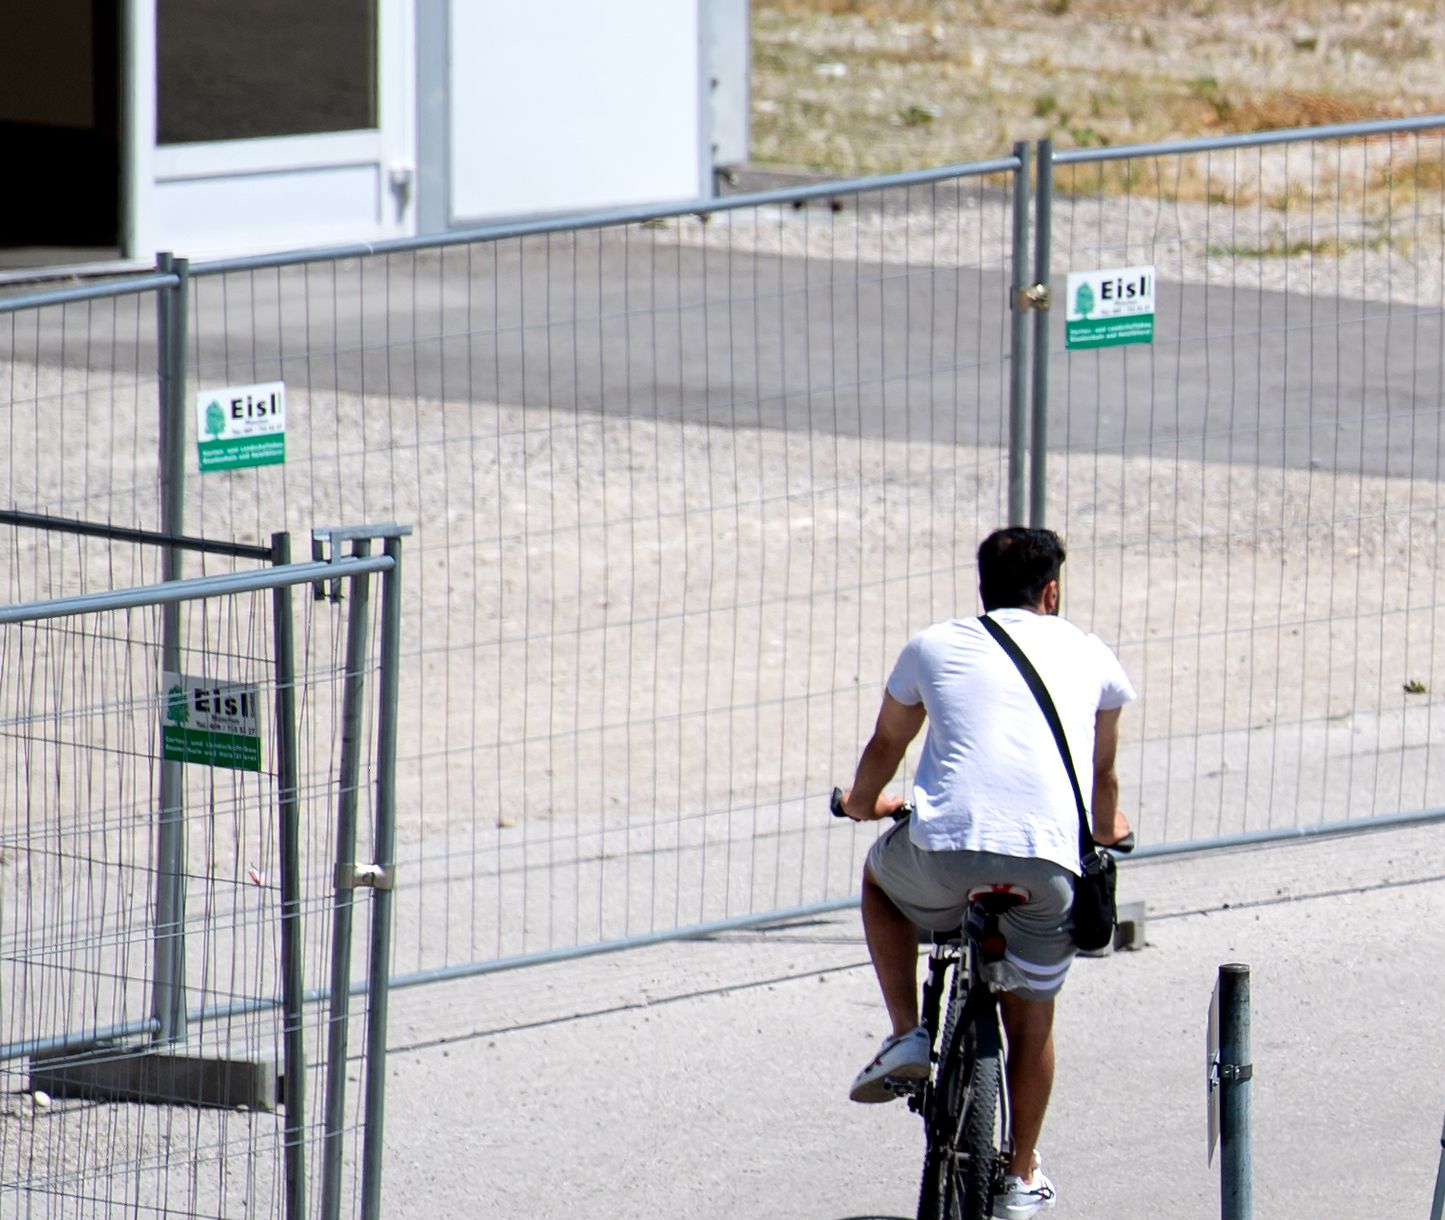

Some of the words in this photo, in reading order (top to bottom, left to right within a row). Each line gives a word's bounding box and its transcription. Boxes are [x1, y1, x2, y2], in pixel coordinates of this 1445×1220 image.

[1100, 277, 1146, 301] Eisl
[230, 394, 276, 420] Eisl
[194, 688, 248, 718] Eisl
